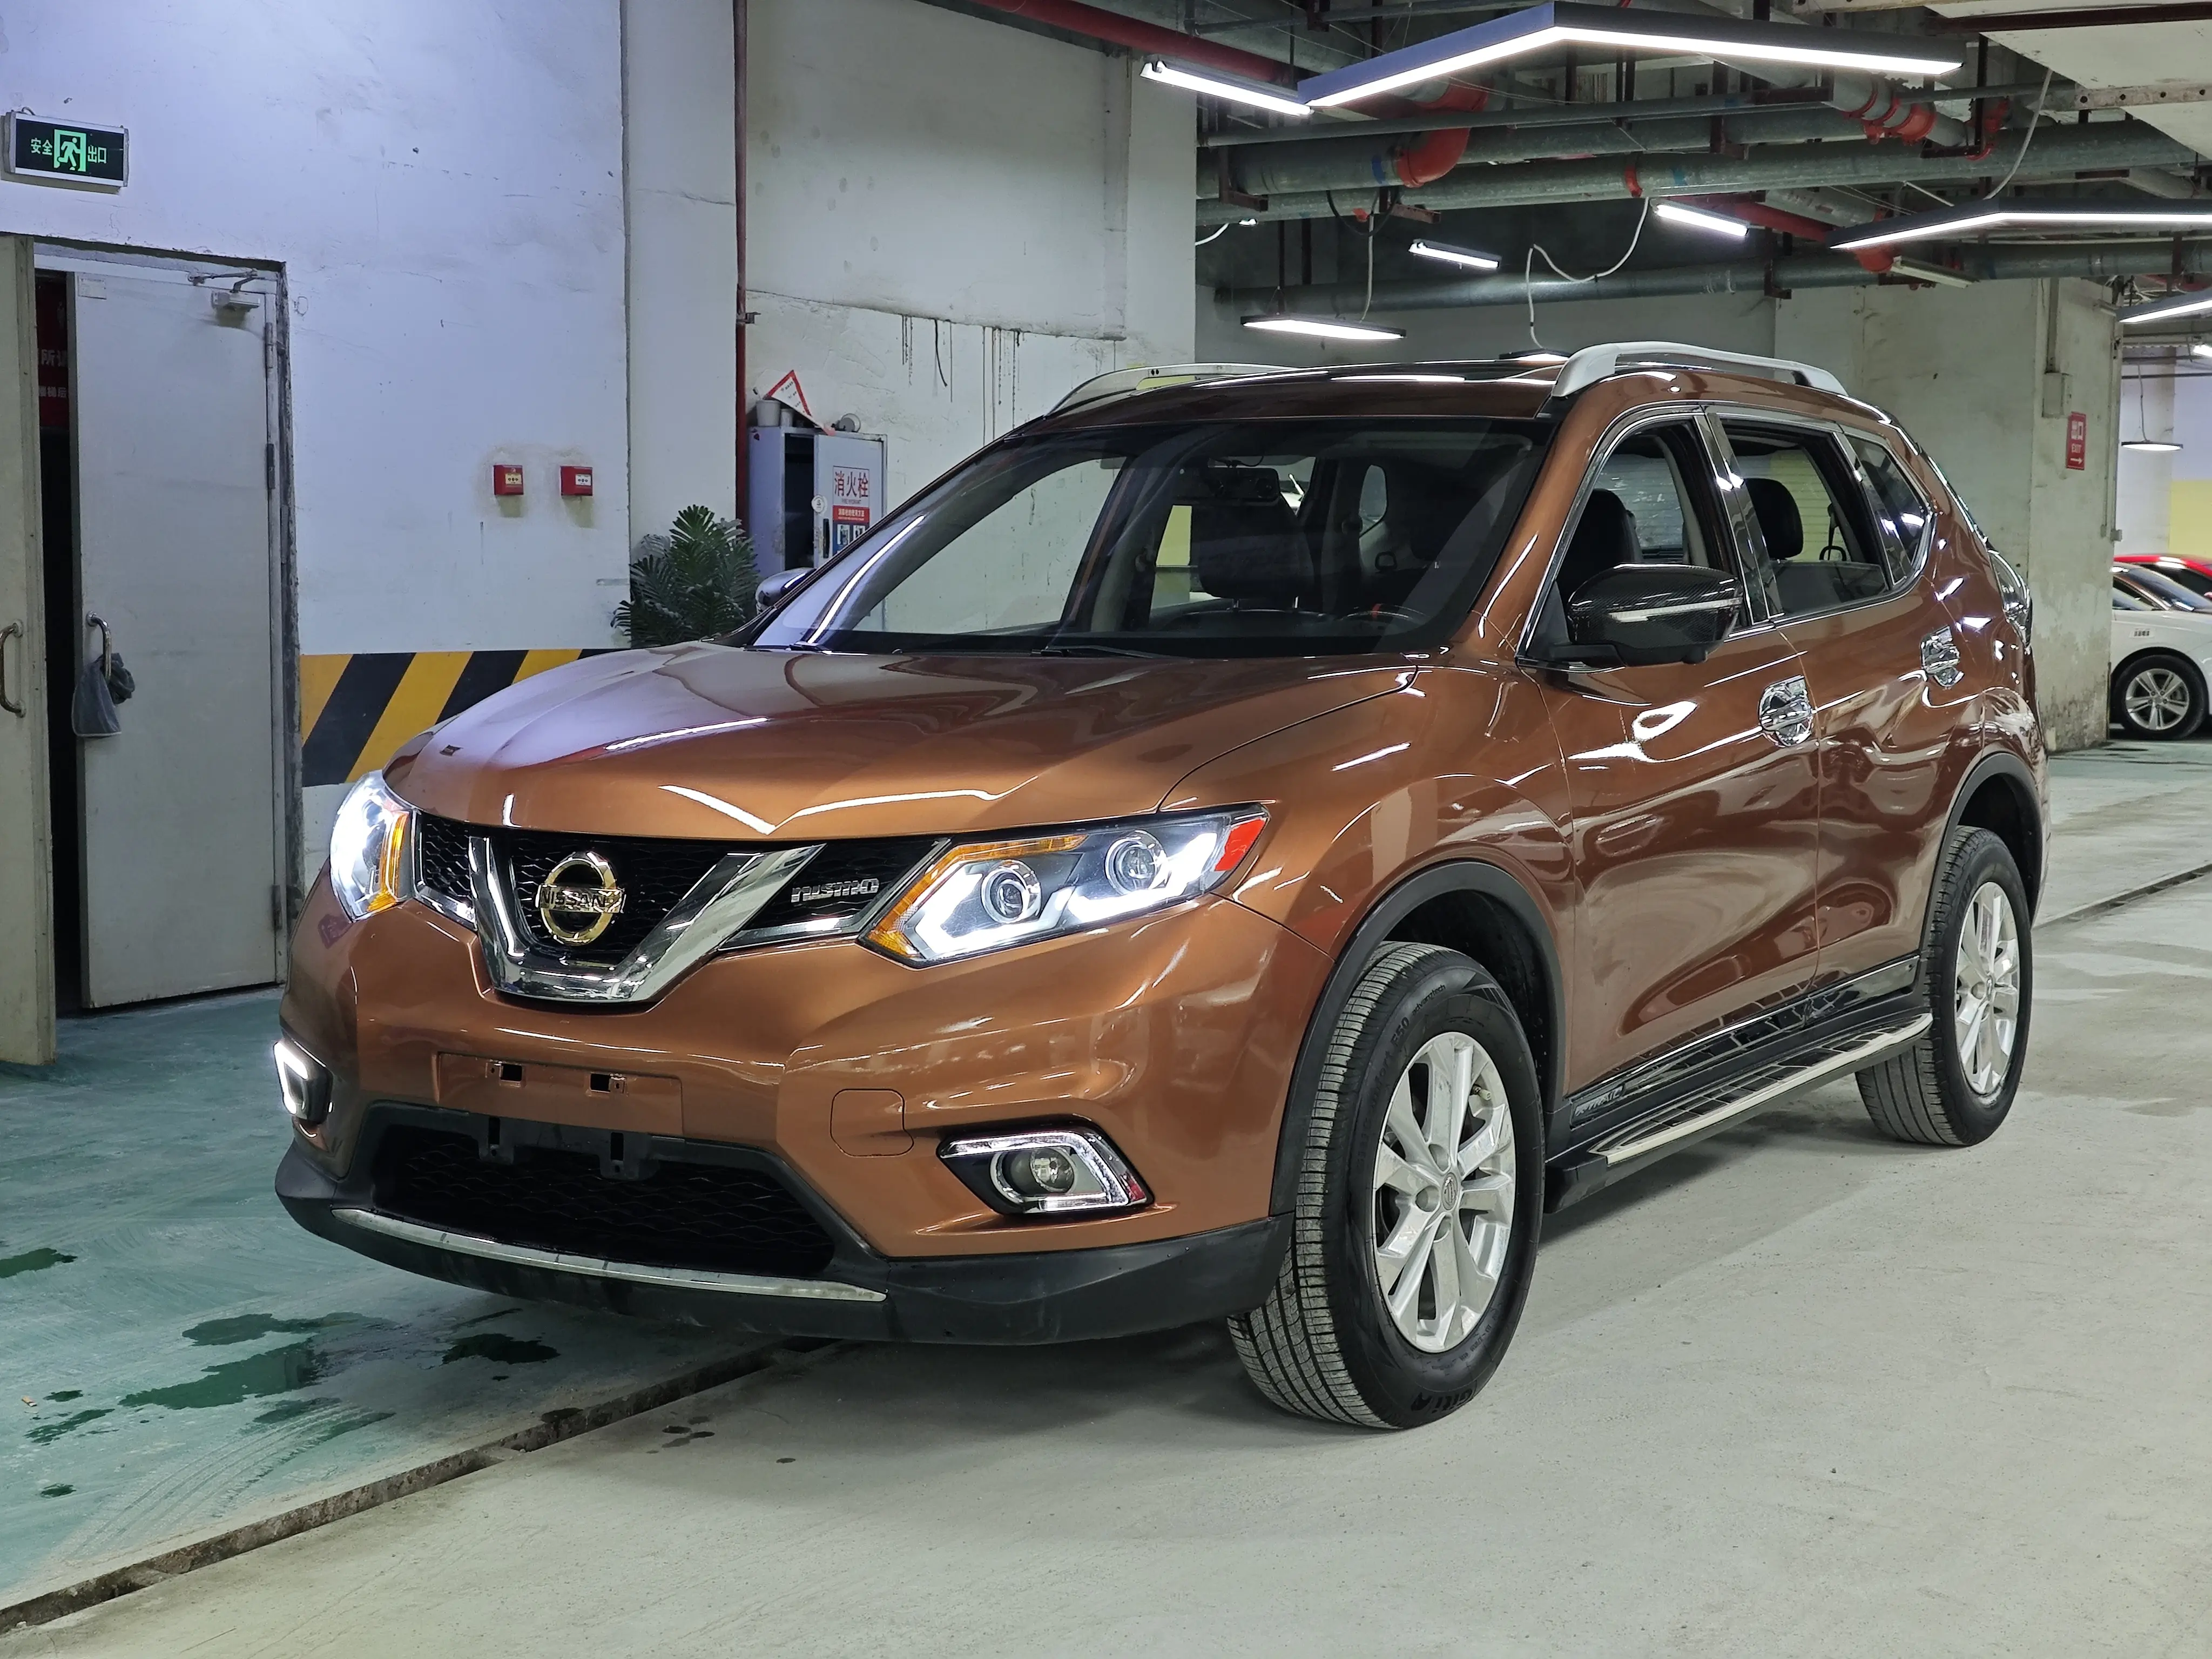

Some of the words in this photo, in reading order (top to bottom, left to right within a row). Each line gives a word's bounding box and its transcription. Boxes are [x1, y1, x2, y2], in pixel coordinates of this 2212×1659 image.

[31, 138, 53, 156] 安全
[87, 145, 107, 164] 出口
[834, 470, 868, 498] 消火栓
[541, 890, 606, 908] NISSAN
[1390, 1016, 1410, 1047] F50
